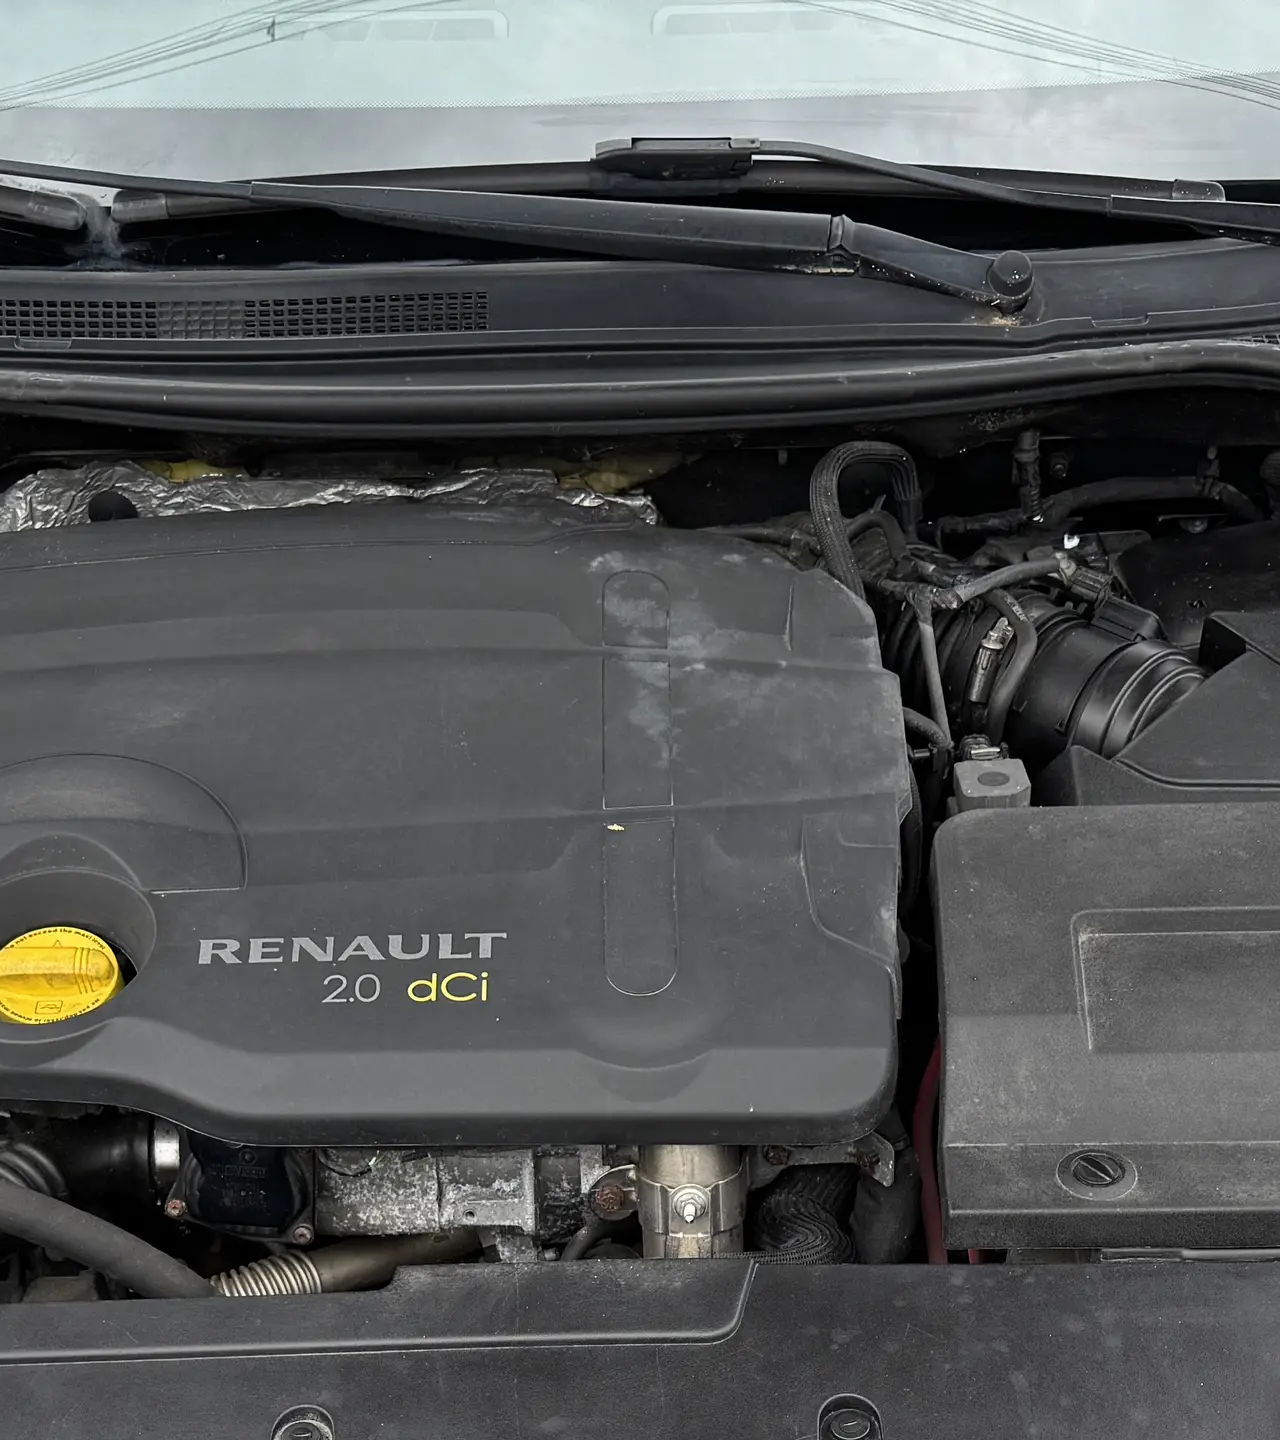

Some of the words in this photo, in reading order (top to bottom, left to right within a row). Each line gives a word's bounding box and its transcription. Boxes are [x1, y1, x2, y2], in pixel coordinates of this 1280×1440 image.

[198, 932, 507, 964] RENAULT
[322, 974, 381, 1003] 2.0
[407, 972, 489, 1002] dCi
